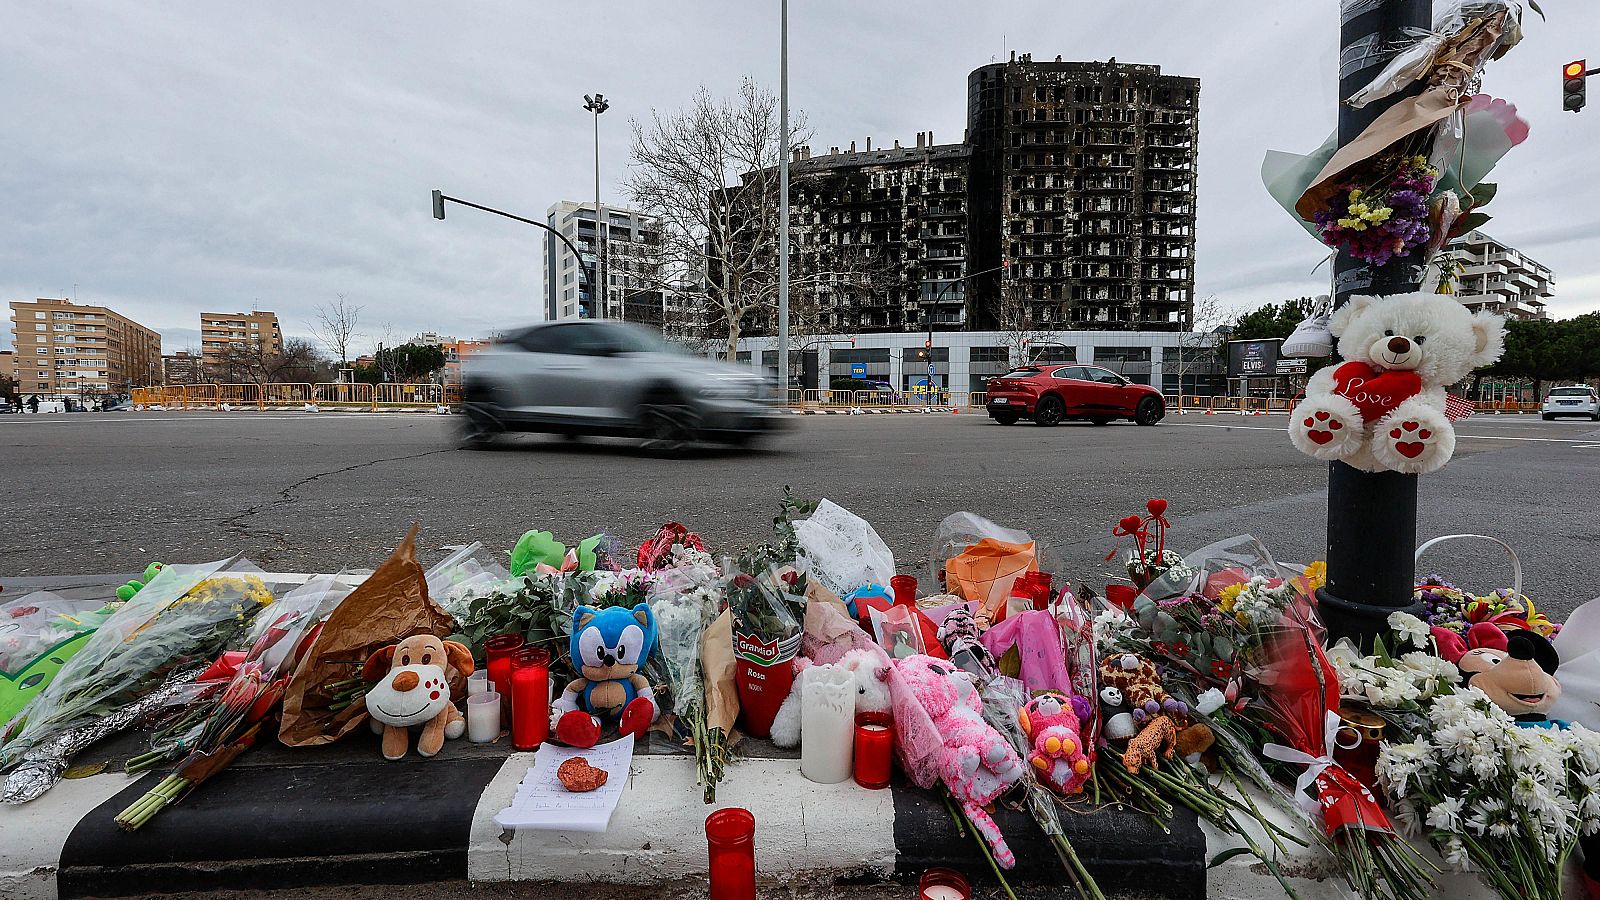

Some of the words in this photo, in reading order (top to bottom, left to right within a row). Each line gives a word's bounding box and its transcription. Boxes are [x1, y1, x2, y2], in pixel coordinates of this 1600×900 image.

[1243, 361, 1262, 370] ELVIS
[1338, 377, 1393, 407] Love
[739, 640, 775, 656] Grandiol
[747, 668, 766, 680] Rosa
